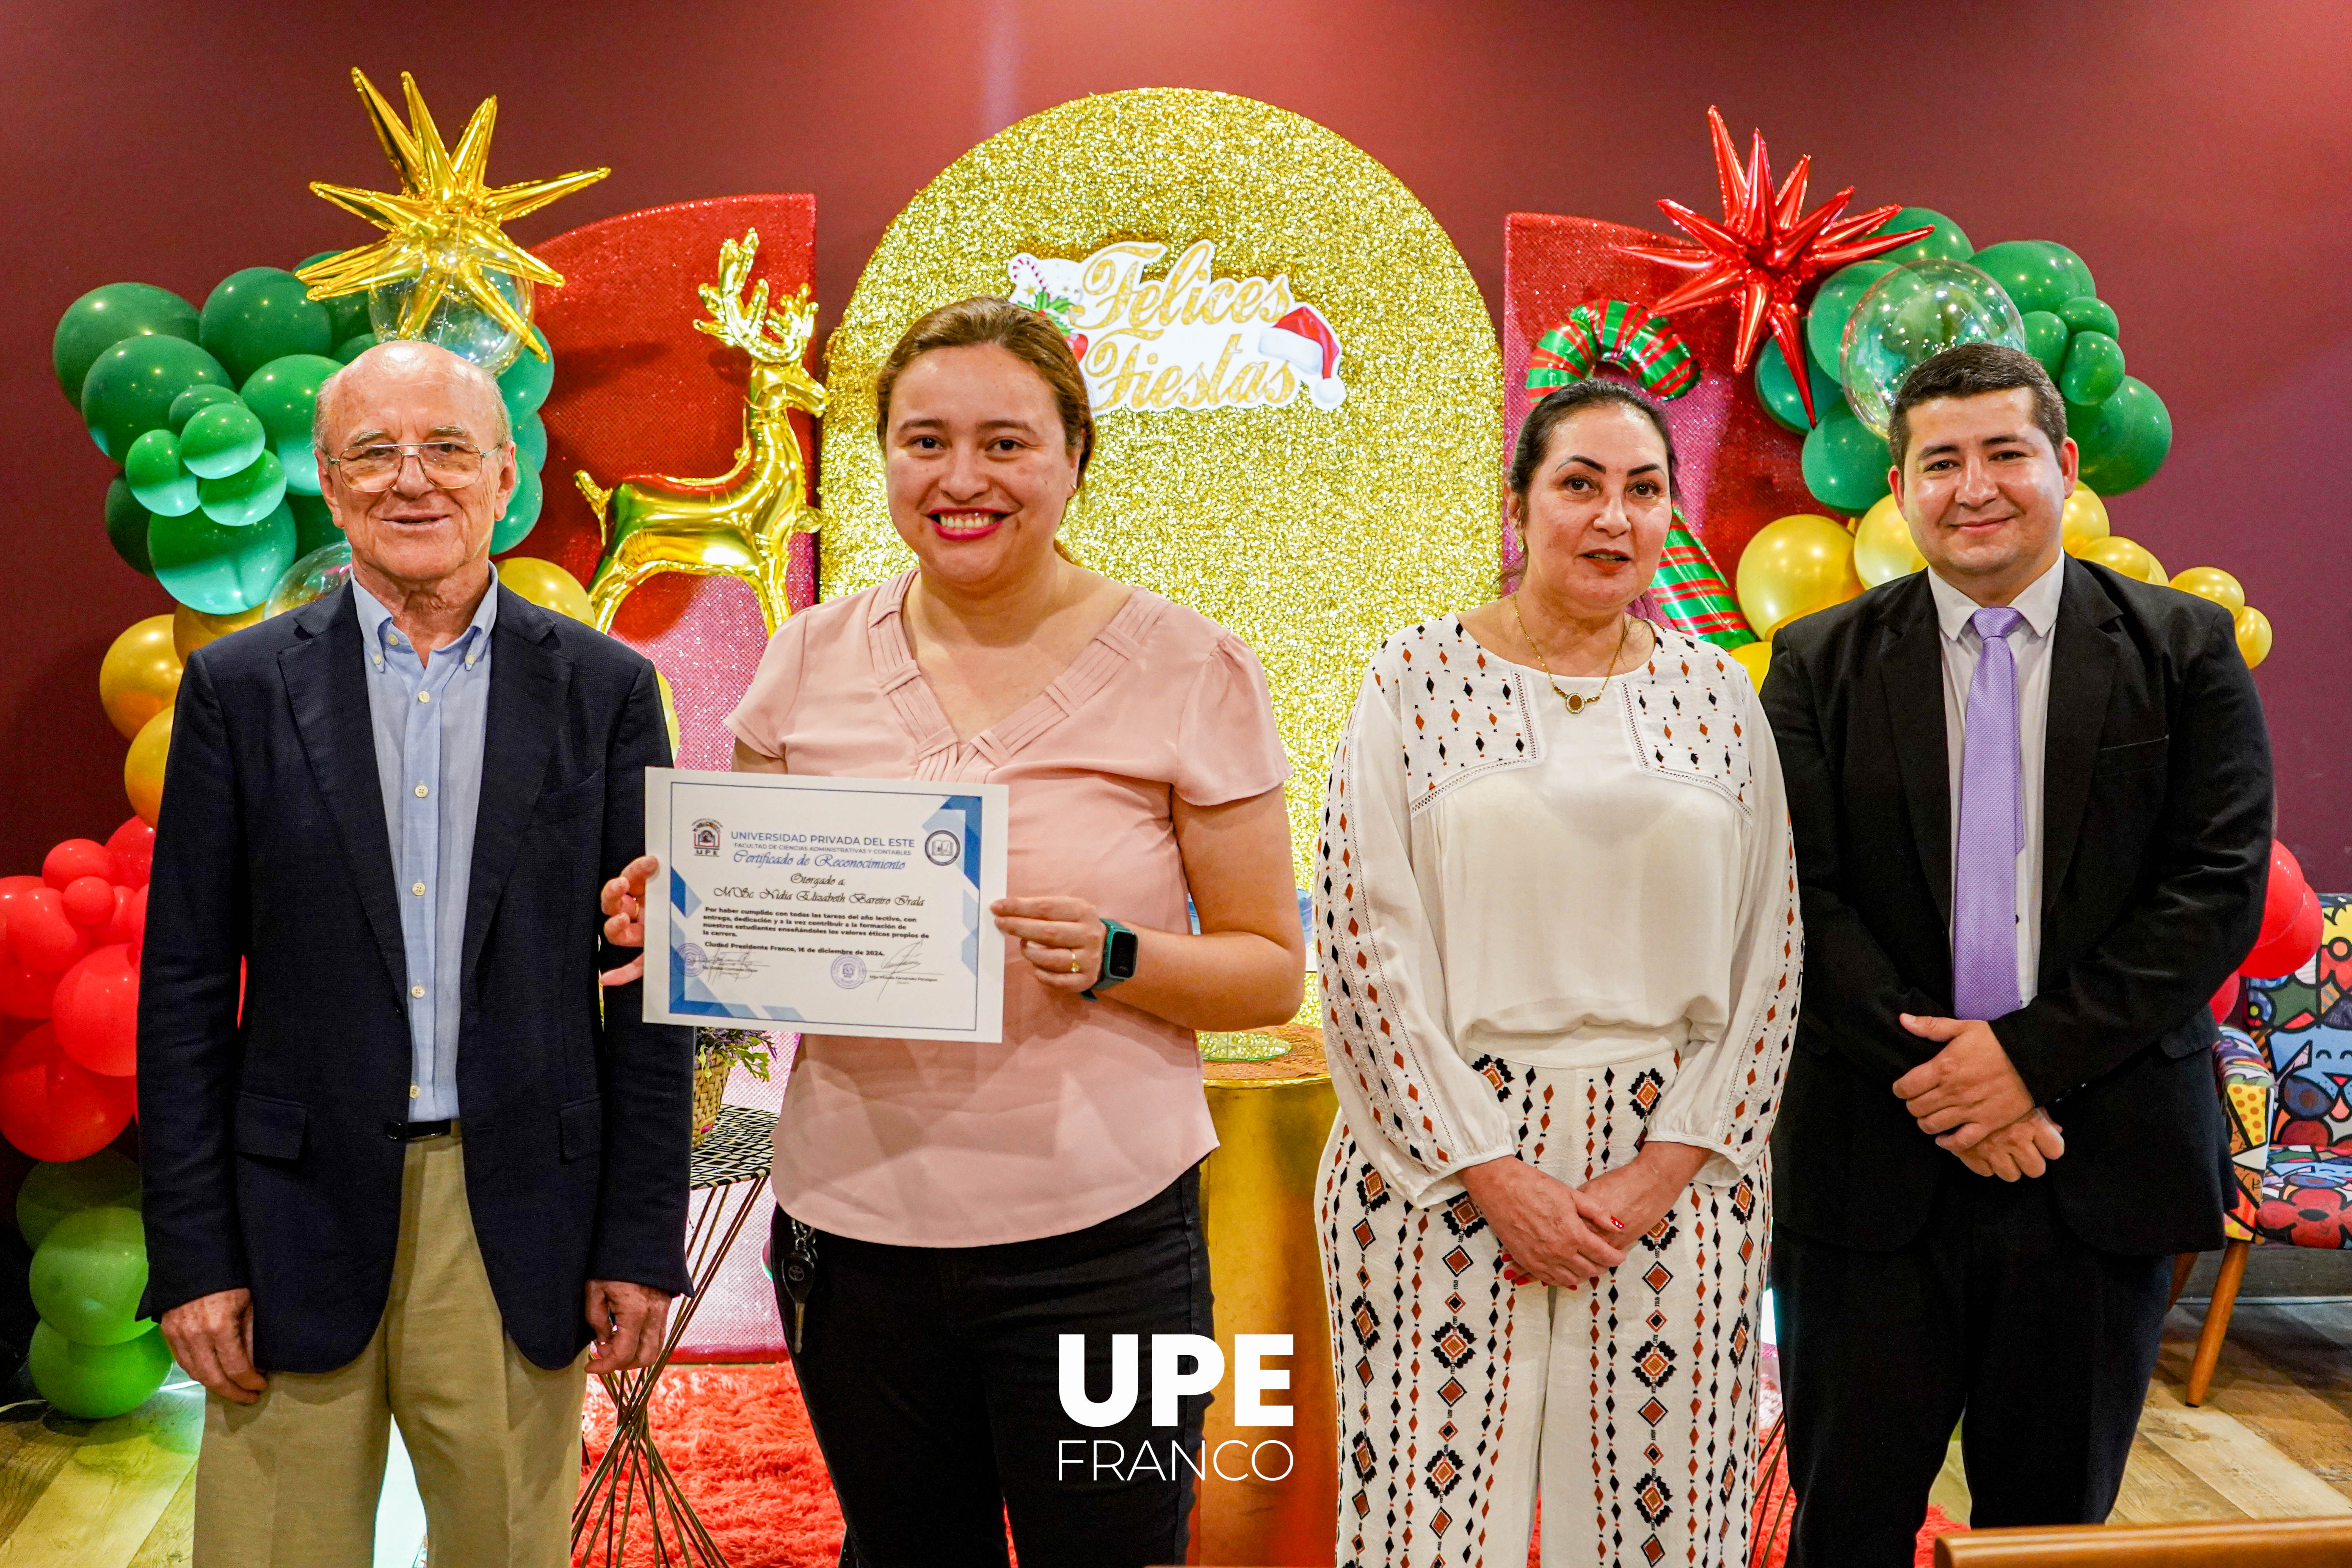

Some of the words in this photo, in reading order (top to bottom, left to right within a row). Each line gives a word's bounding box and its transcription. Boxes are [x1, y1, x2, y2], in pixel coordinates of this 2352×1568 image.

[1068, 242, 1290, 329] Felices
[1085, 328, 1296, 410] Fiestas
[731, 831, 807, 843] UNIVERSIDAD
[811, 835, 860, 845] PRIVADA
[864, 837, 886, 846] DEL
[889, 838, 915, 848] ESTE
[733, 850, 793, 868] Certificado
[796, 853, 810, 866] de
[815, 854, 905, 870] Reconocimiento
[790, 873, 836, 888] Otorgado
[759, 888, 794, 900] Nidia
[796, 891, 846, 903] Elizabeth
[849, 893, 891, 905] Bareiro
[778, 926, 827, 935] enseñándoles
